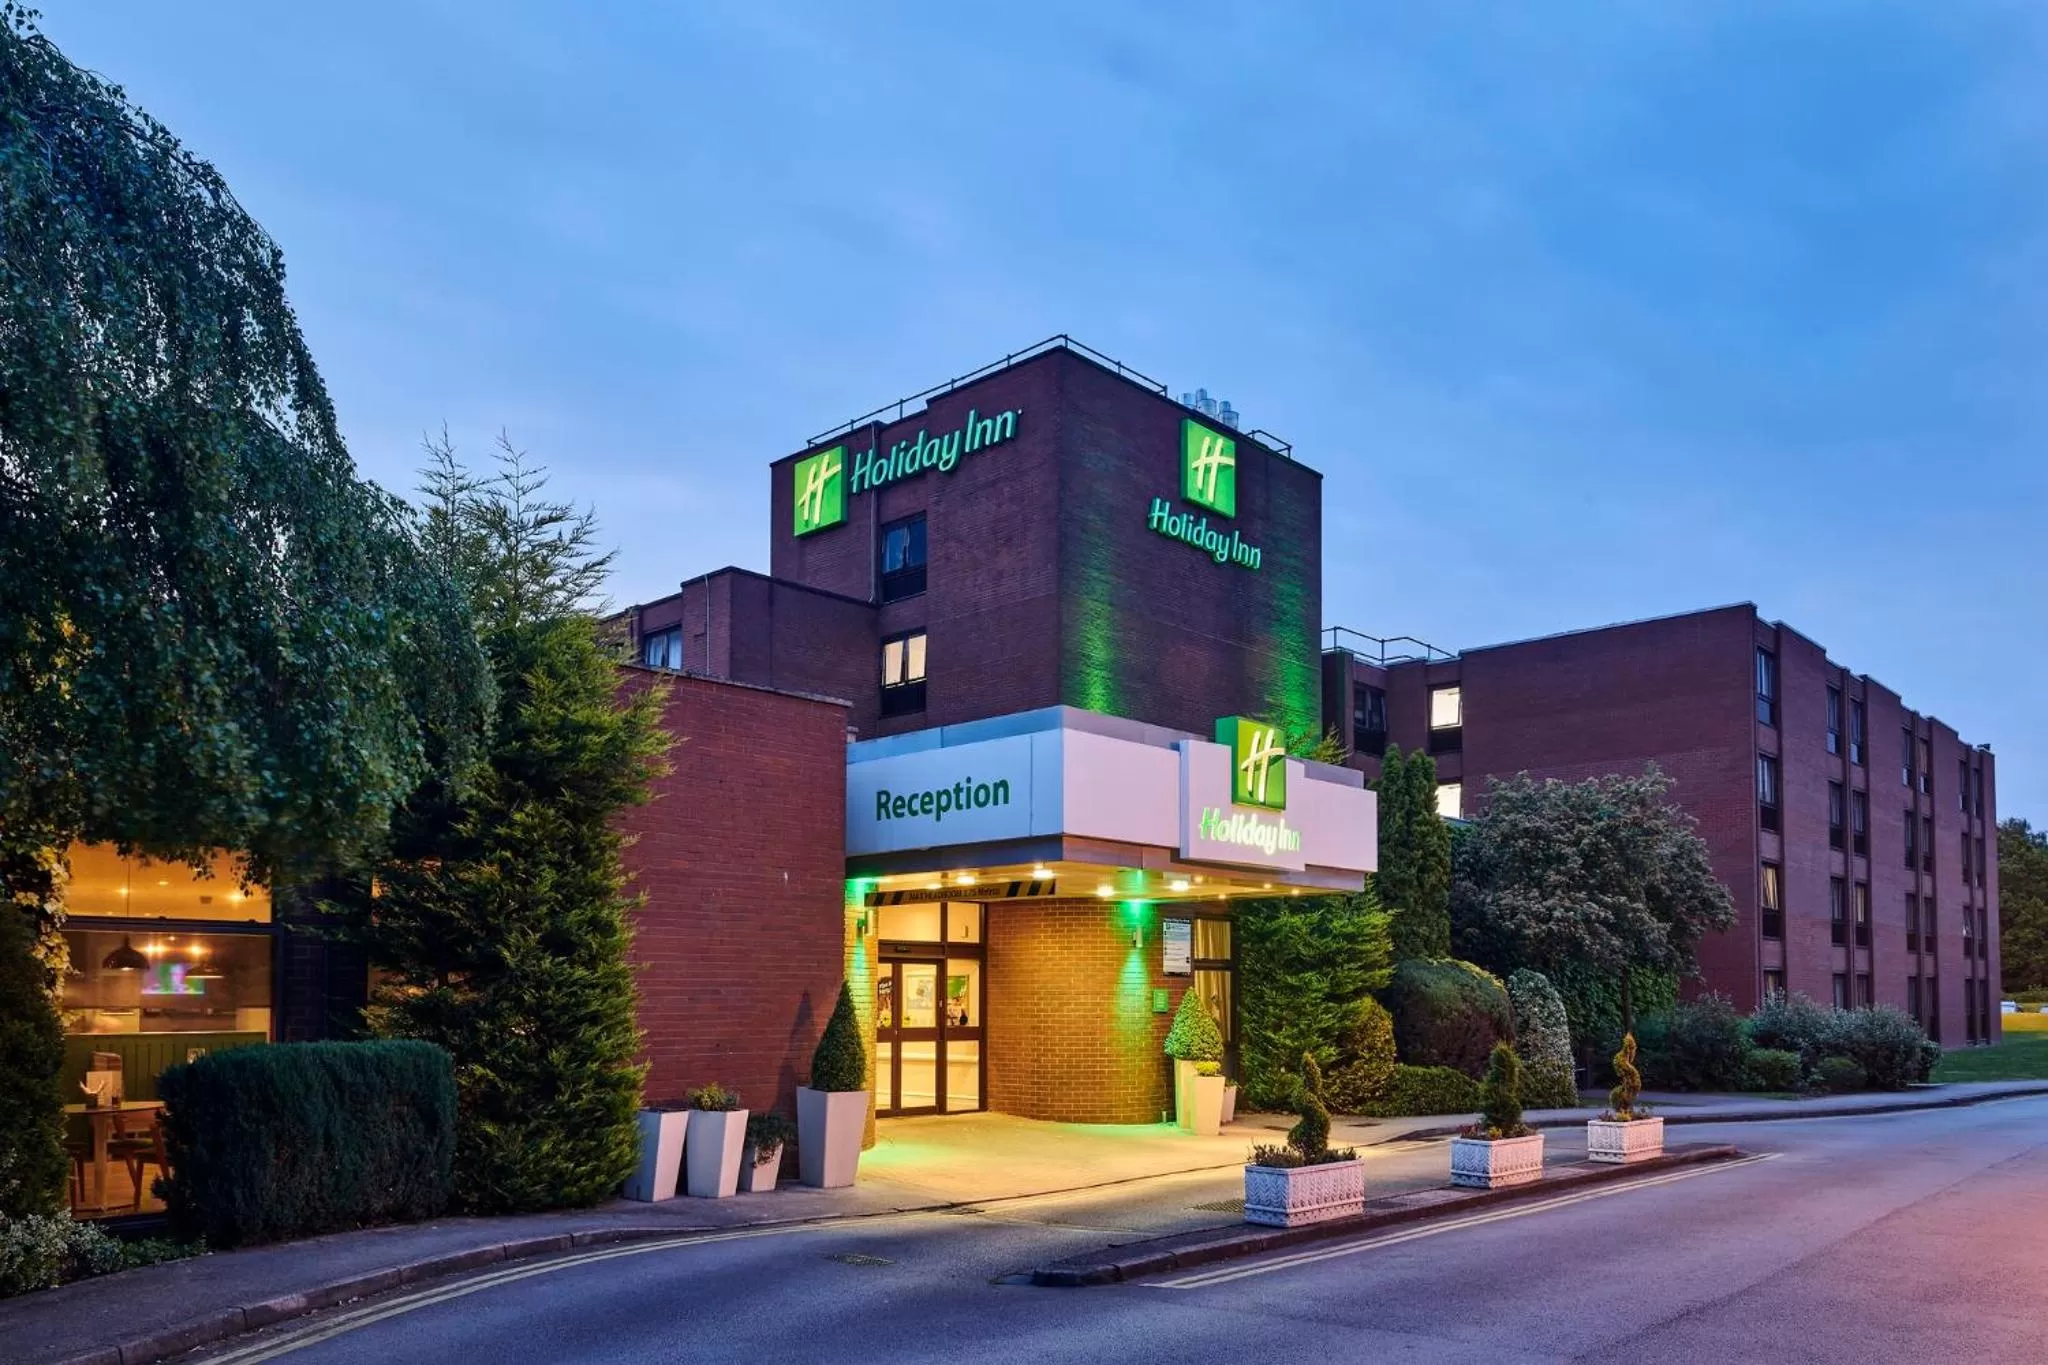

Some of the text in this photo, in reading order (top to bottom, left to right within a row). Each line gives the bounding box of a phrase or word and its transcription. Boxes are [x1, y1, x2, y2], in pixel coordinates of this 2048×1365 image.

[850, 408, 1017, 494] Holiday Inn
[1148, 497, 1262, 570] Holiday Inn
[875, 775, 1010, 823] Reception
[1199, 806, 1301, 856] Holiday Inn
